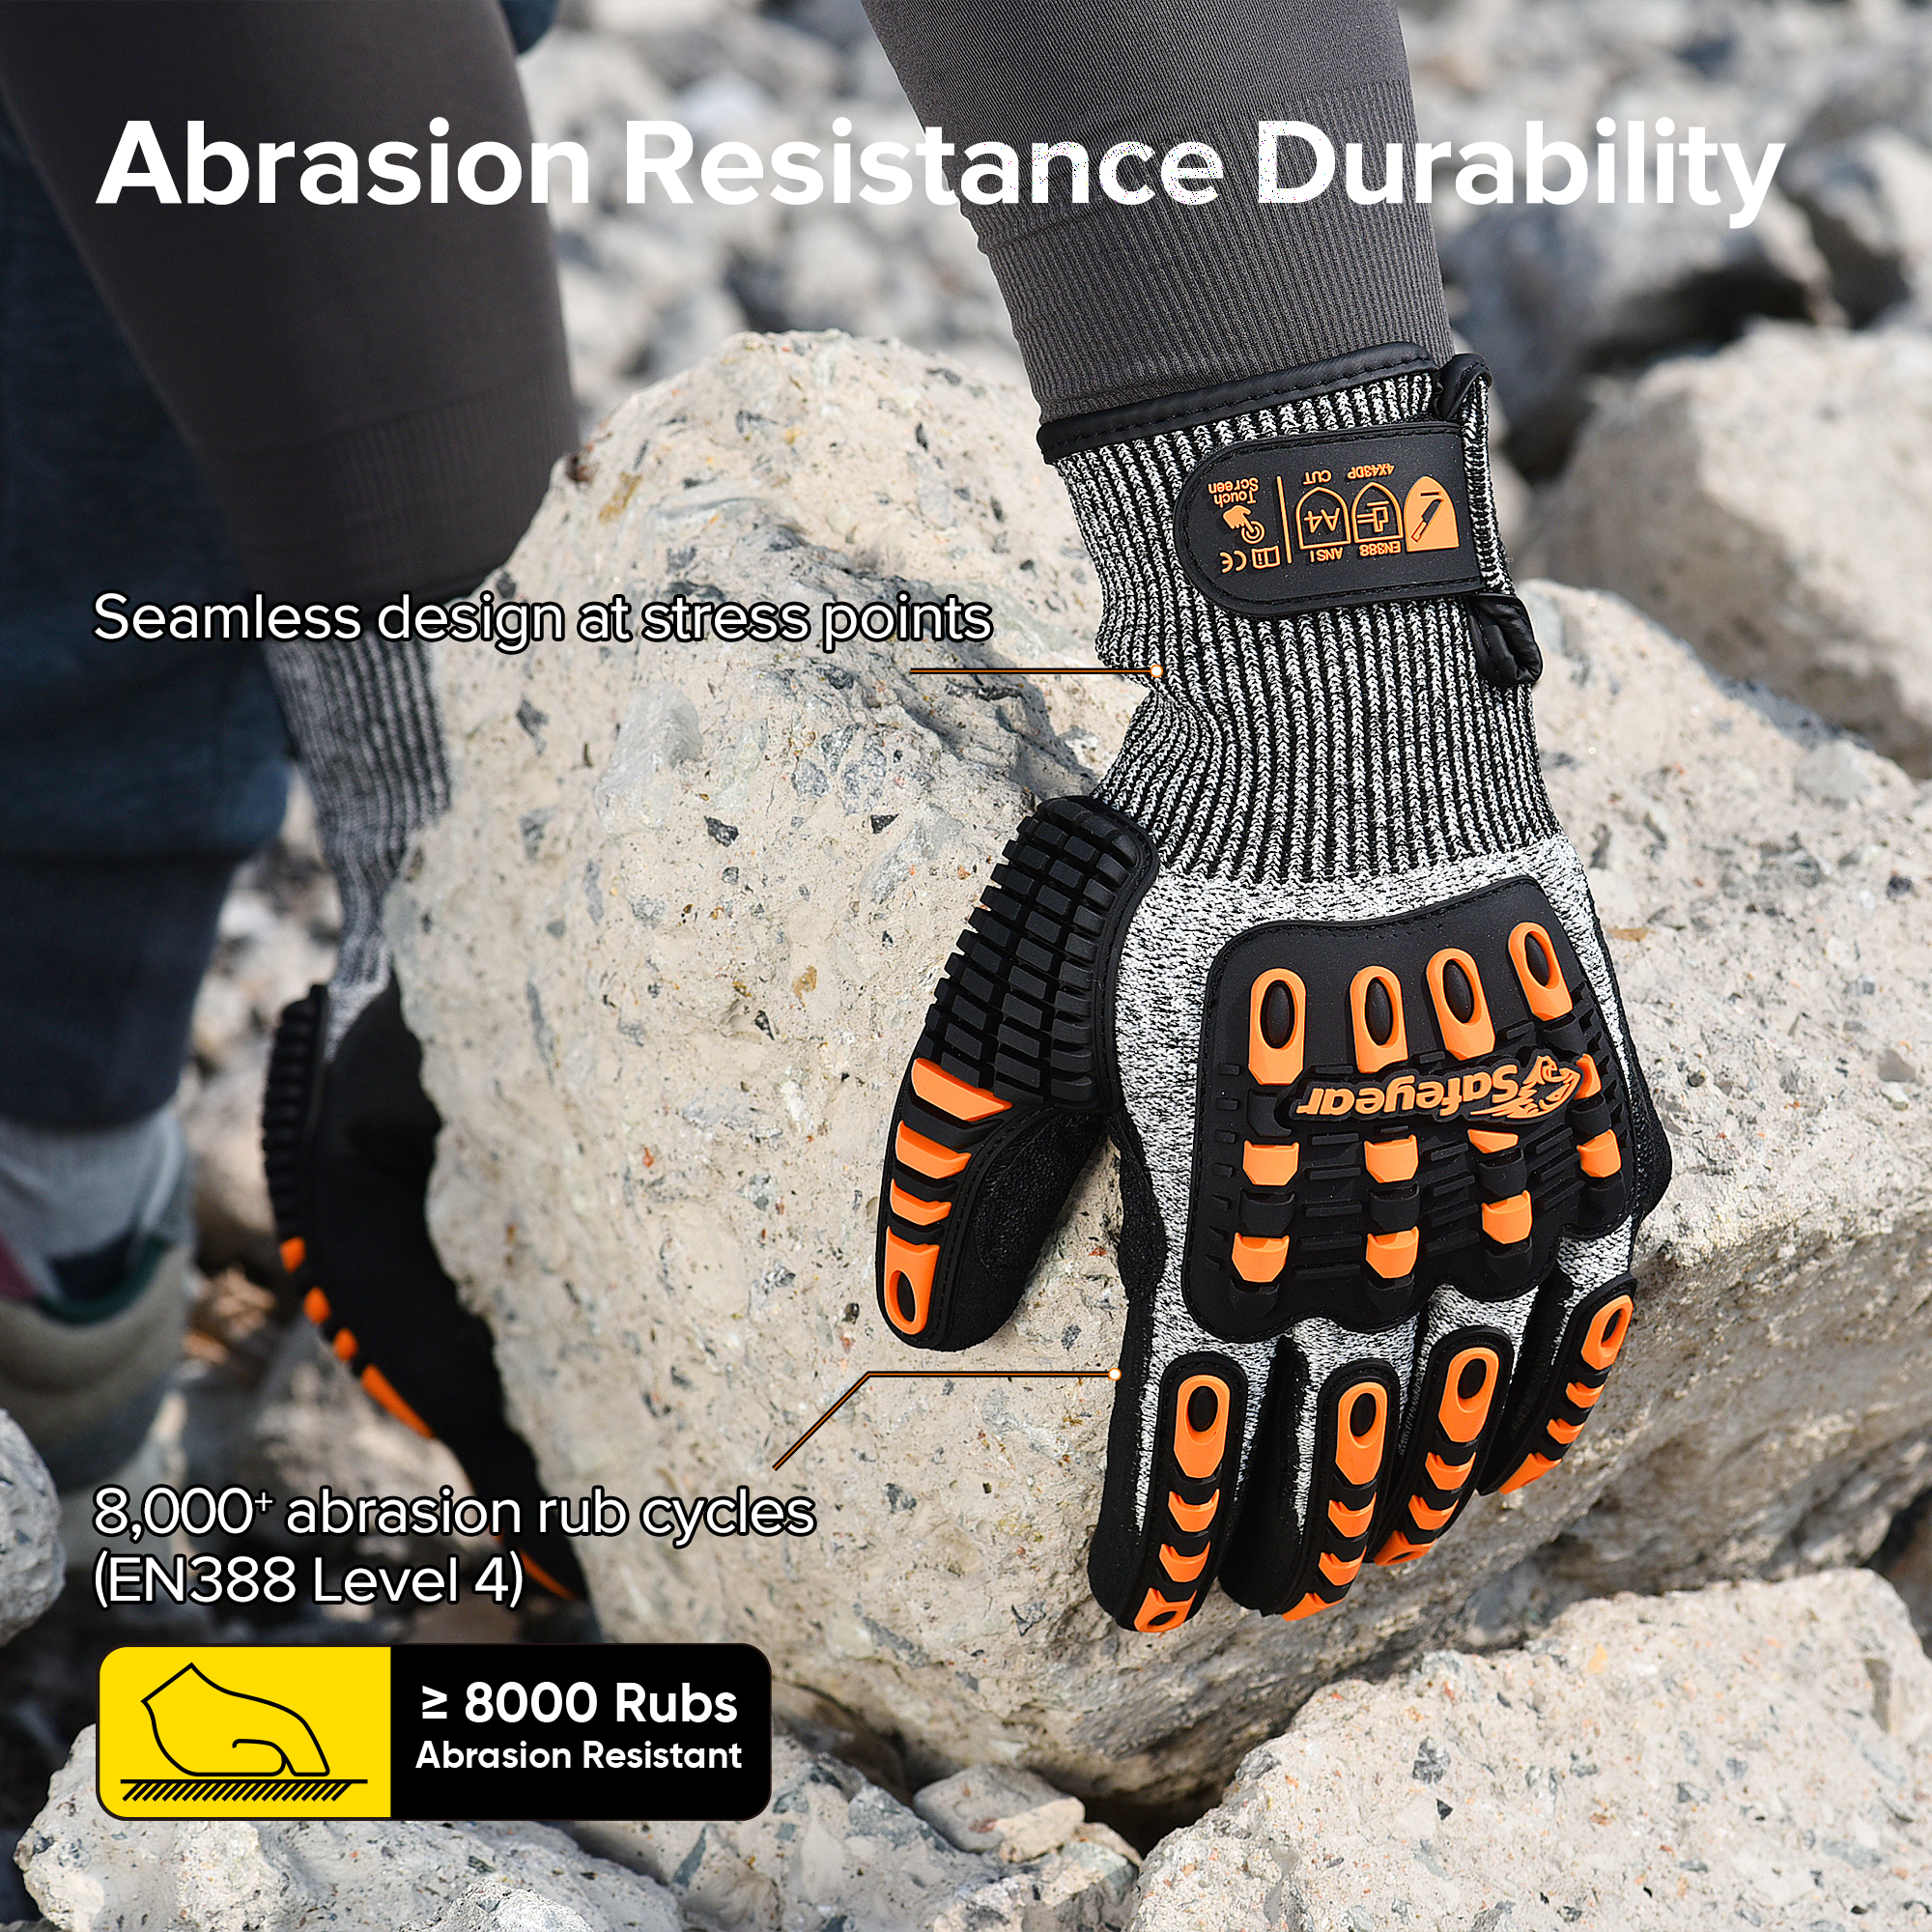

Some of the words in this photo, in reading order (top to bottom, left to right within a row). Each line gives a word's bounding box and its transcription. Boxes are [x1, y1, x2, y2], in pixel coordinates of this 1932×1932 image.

[1303, 470, 1331, 484] CUT
[1347, 463, 1395, 479] 4X43DP
[1208, 477, 1259, 496] Screen
[1213, 490, 1256, 507] Touch
[1304, 508, 1341, 533] A4
[1309, 547, 1343, 561] ANSI
[1359, 541, 1401, 556] EN388
[1296, 1065, 1519, 1117] Safeyear
